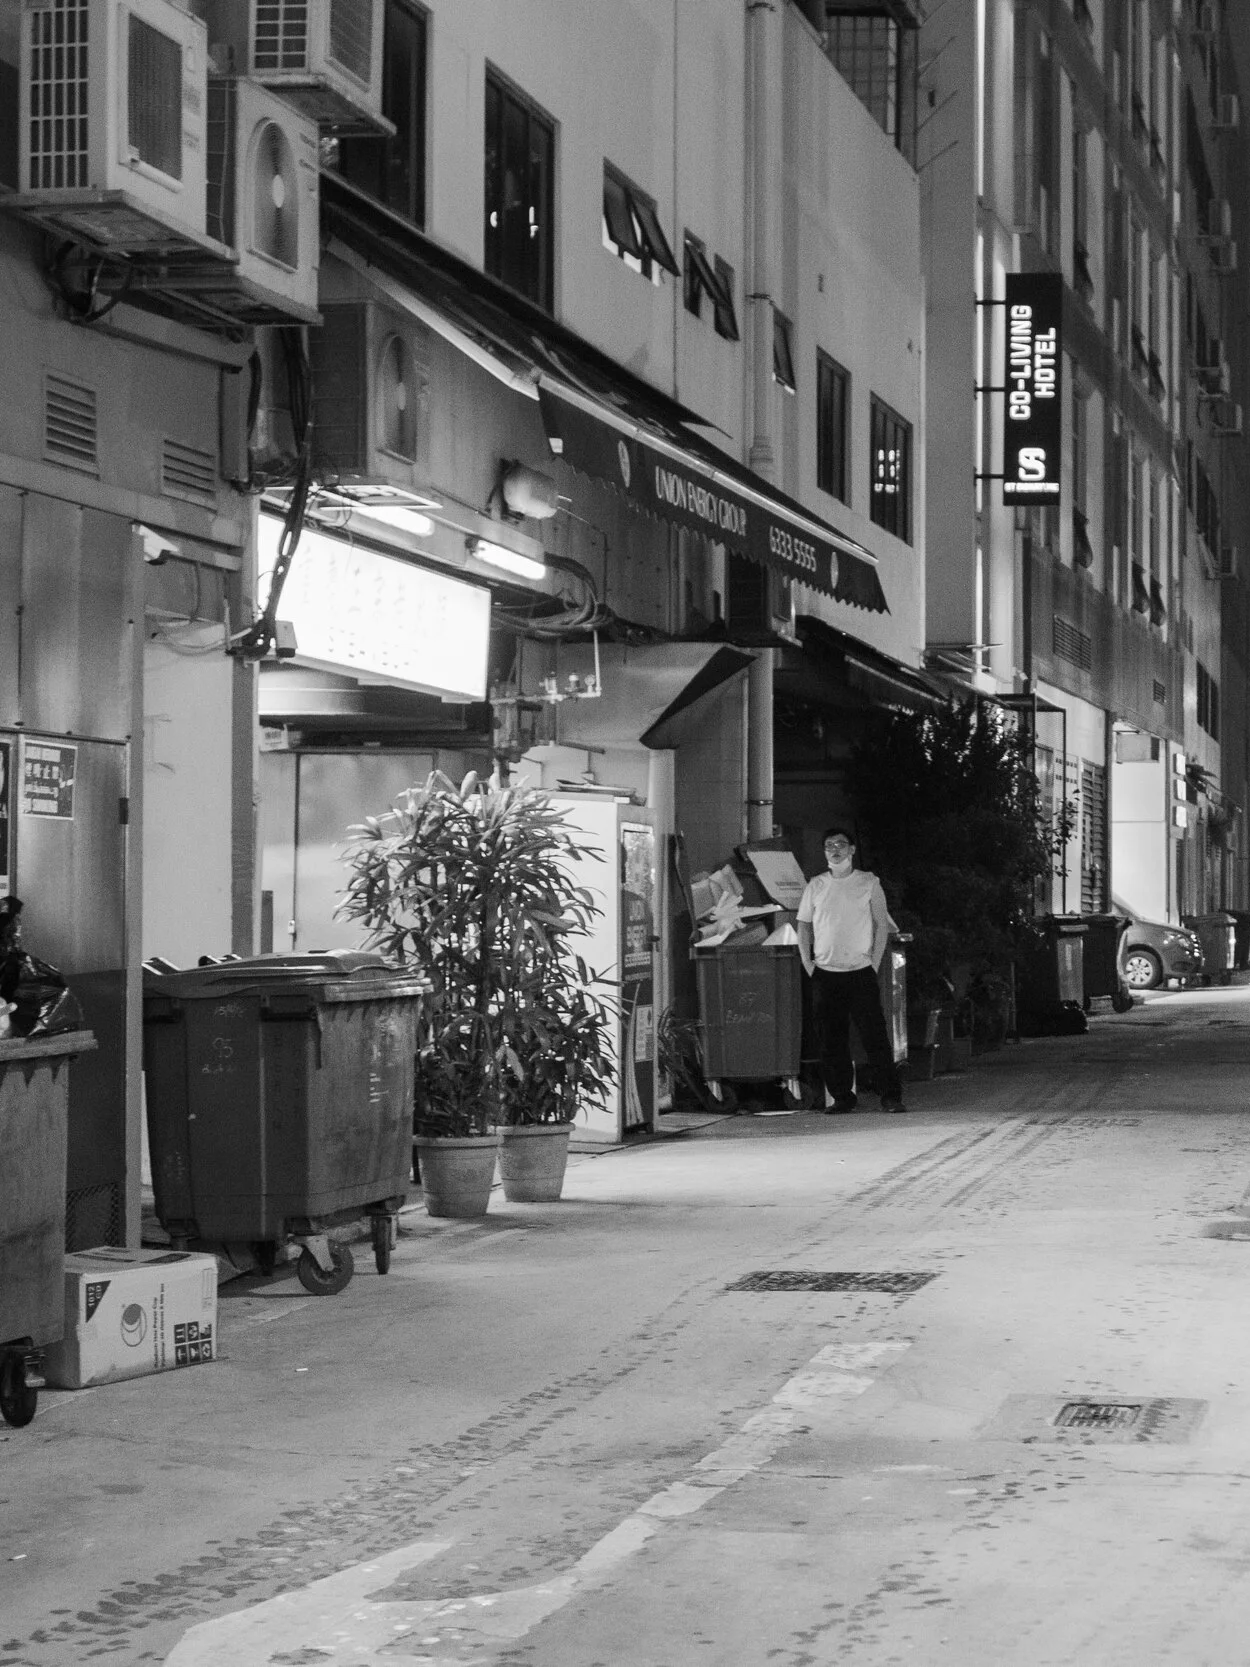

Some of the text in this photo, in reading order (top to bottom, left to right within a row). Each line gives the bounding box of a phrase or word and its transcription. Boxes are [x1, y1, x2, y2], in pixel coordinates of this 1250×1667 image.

[1009, 304, 1032, 421] CO-LIVING
[1034, 327, 1056, 399] HOTEL
[655, 465, 687, 510] UNION
[769, 525, 817, 573] 6333 5555
